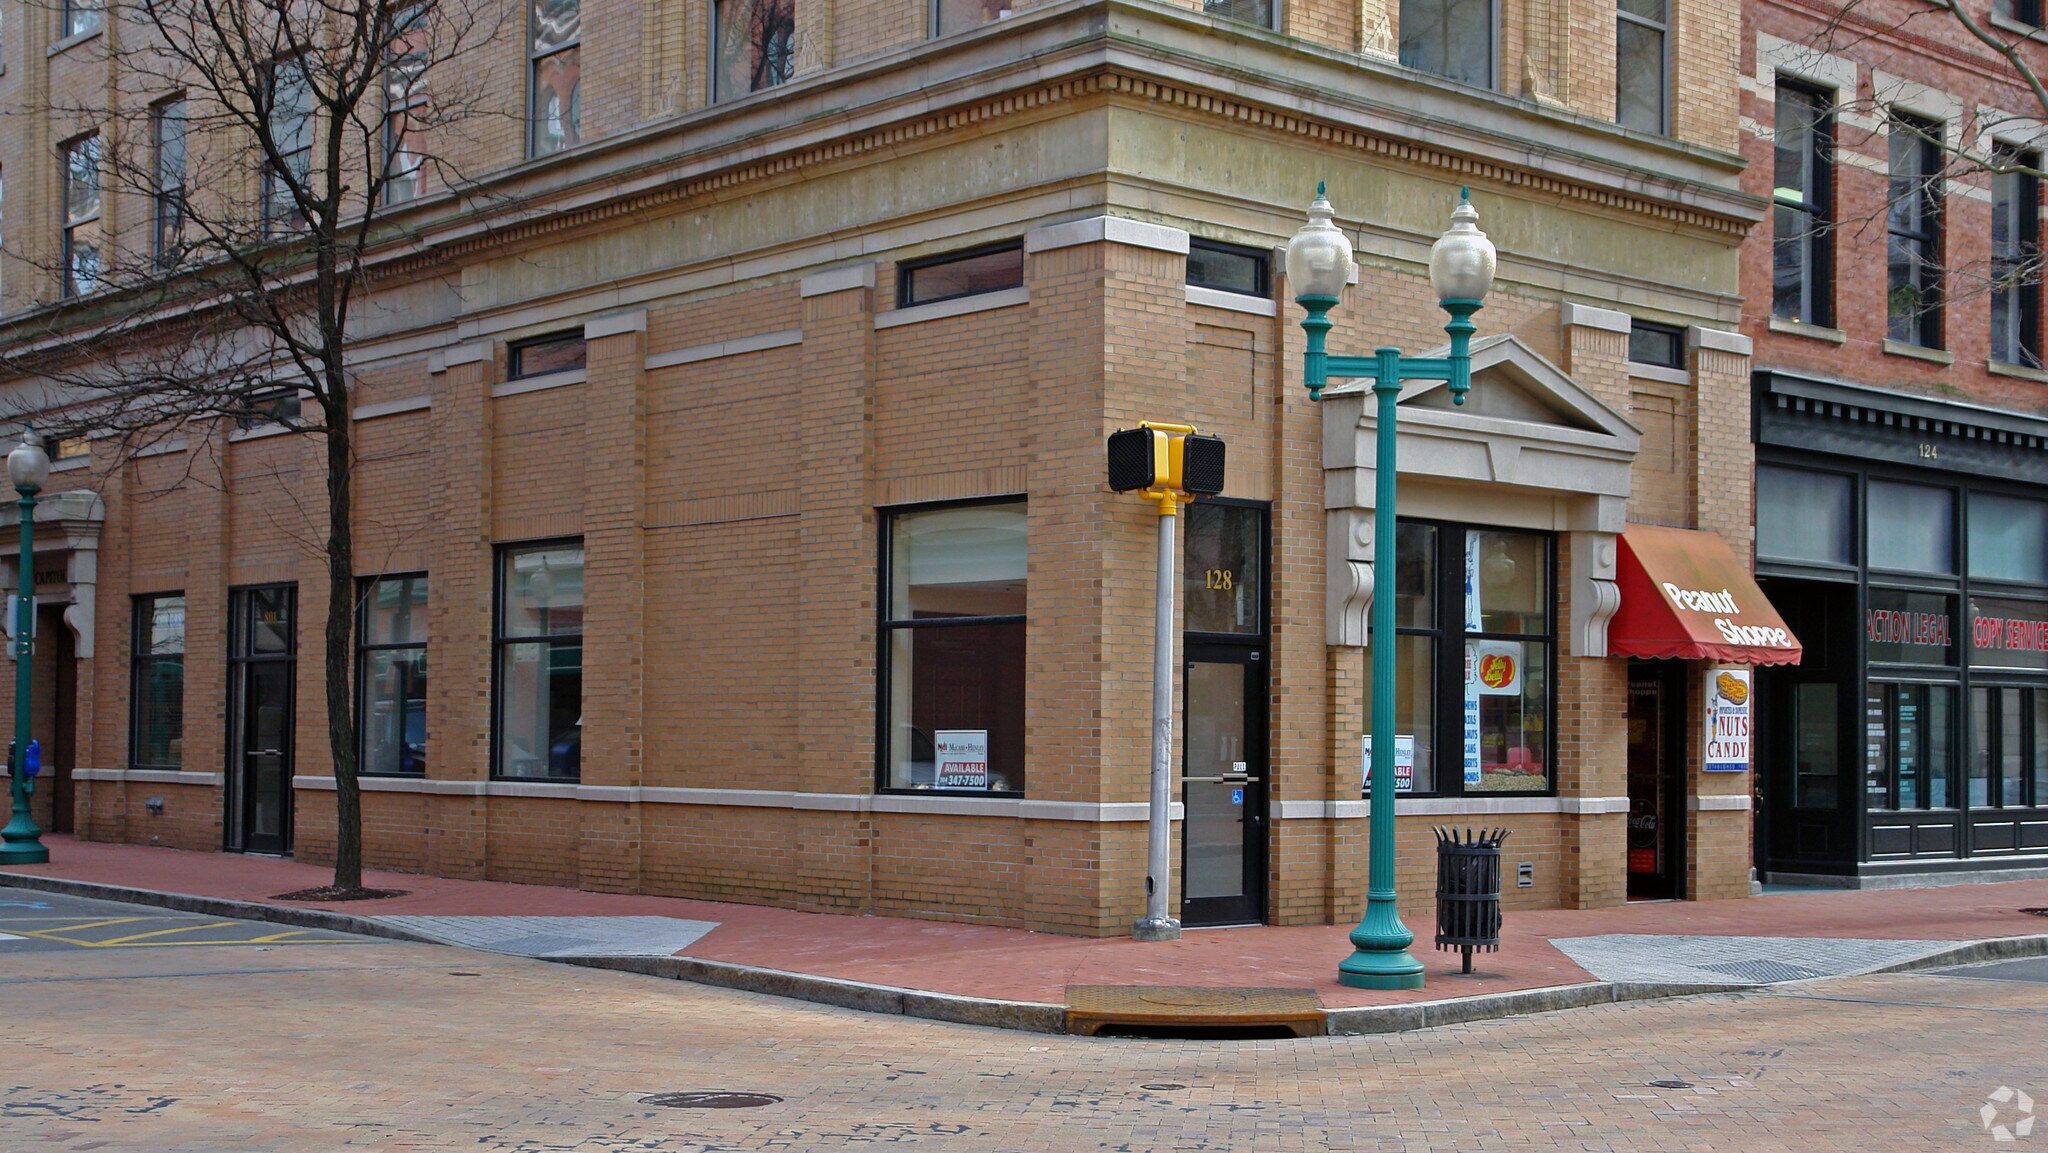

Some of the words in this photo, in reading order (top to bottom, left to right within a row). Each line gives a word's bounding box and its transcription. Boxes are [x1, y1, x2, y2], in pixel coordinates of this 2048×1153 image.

[1919, 443, 1938, 459] 124
[1205, 569, 1232, 590] 128
[1662, 582, 1740, 614] Peanut
[1714, 618, 1791, 647] Shoppe
[1867, 608, 1911, 644] ACTION
[1914, 612, 1952, 646] LEGAL
[1973, 616, 2004, 648] COPY
[1719, 716, 1748, 736] NUTS
[1707, 741, 1747, 758] CANDY
[944, 763, 984, 773] AVAILABLE
